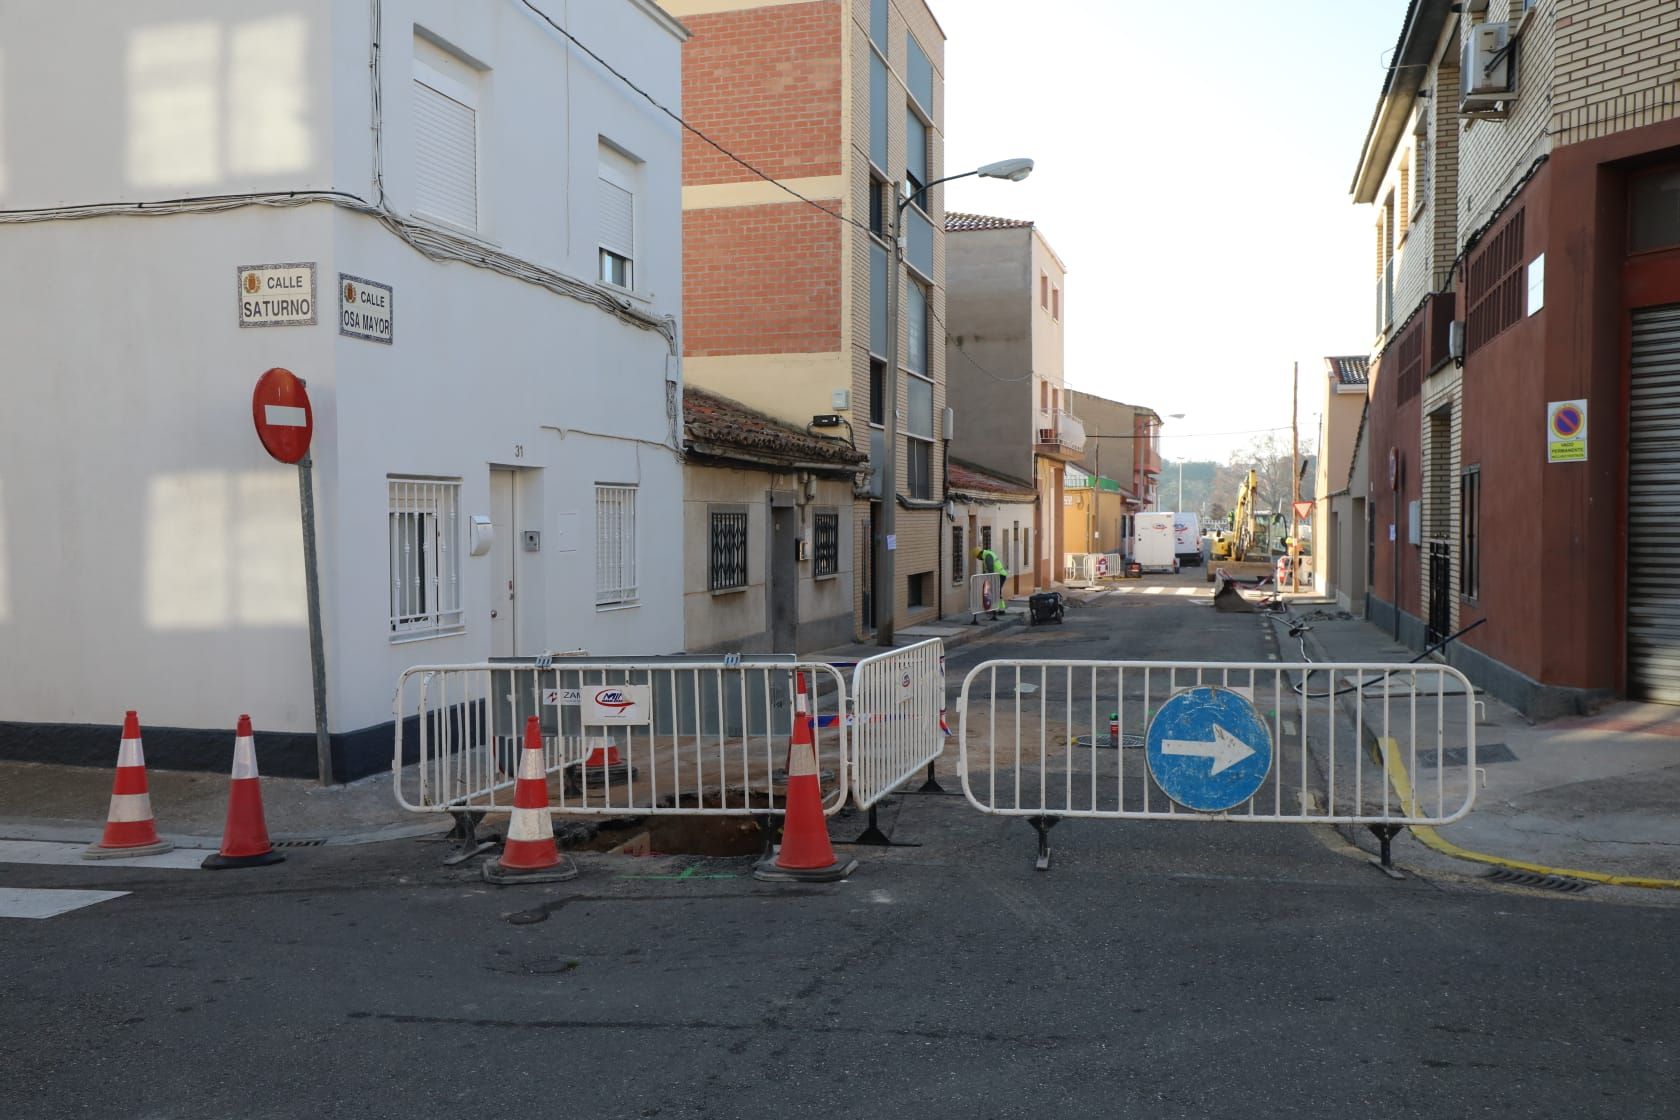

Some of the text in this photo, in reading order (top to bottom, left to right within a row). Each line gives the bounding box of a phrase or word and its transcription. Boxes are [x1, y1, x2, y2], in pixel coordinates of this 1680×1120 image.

[267, 276, 303, 289] CALLE
[360, 291, 385, 308] CALLE
[243, 299, 310, 318] SATURNO
[343, 310, 390, 335] OSA MAYOR
[514, 444, 524, 458] 31
